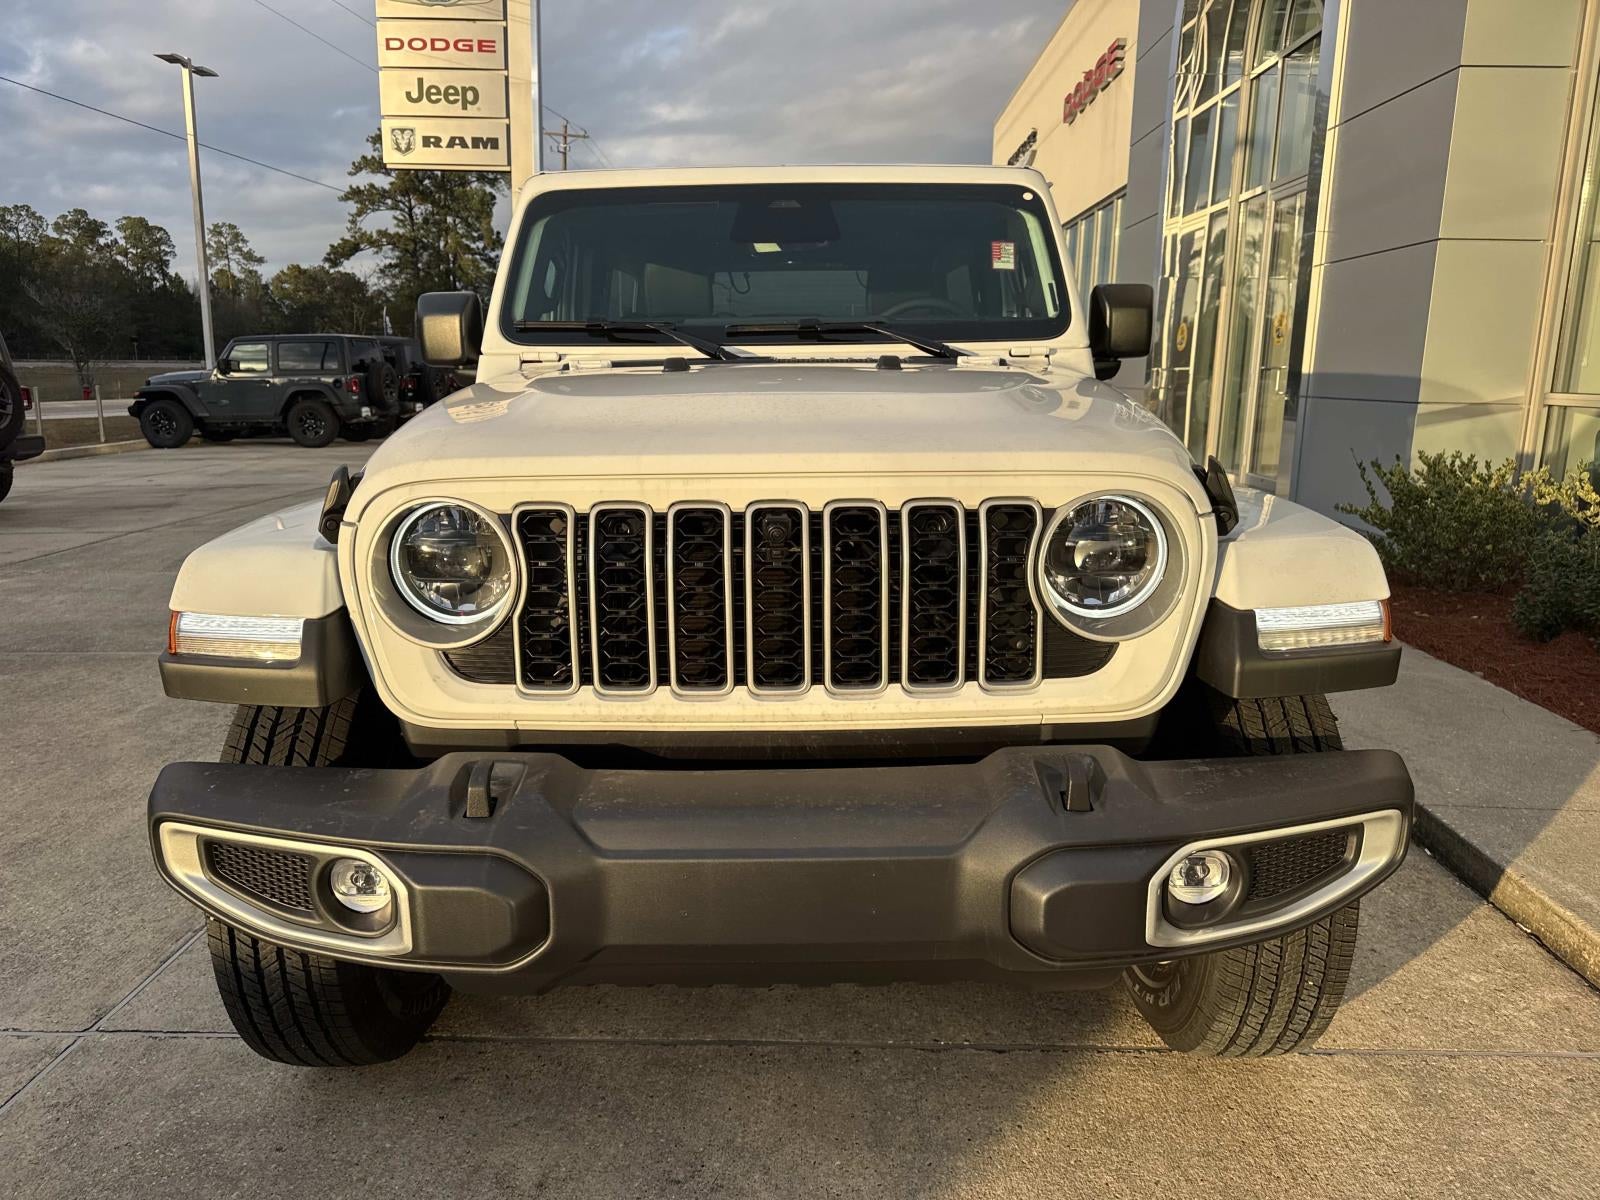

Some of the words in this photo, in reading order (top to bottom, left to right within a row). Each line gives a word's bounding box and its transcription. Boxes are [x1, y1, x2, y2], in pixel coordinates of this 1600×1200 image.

[385, 37, 497, 54] DODGE
[405, 77, 480, 111] Jeep
[421, 135, 499, 150] RAM
